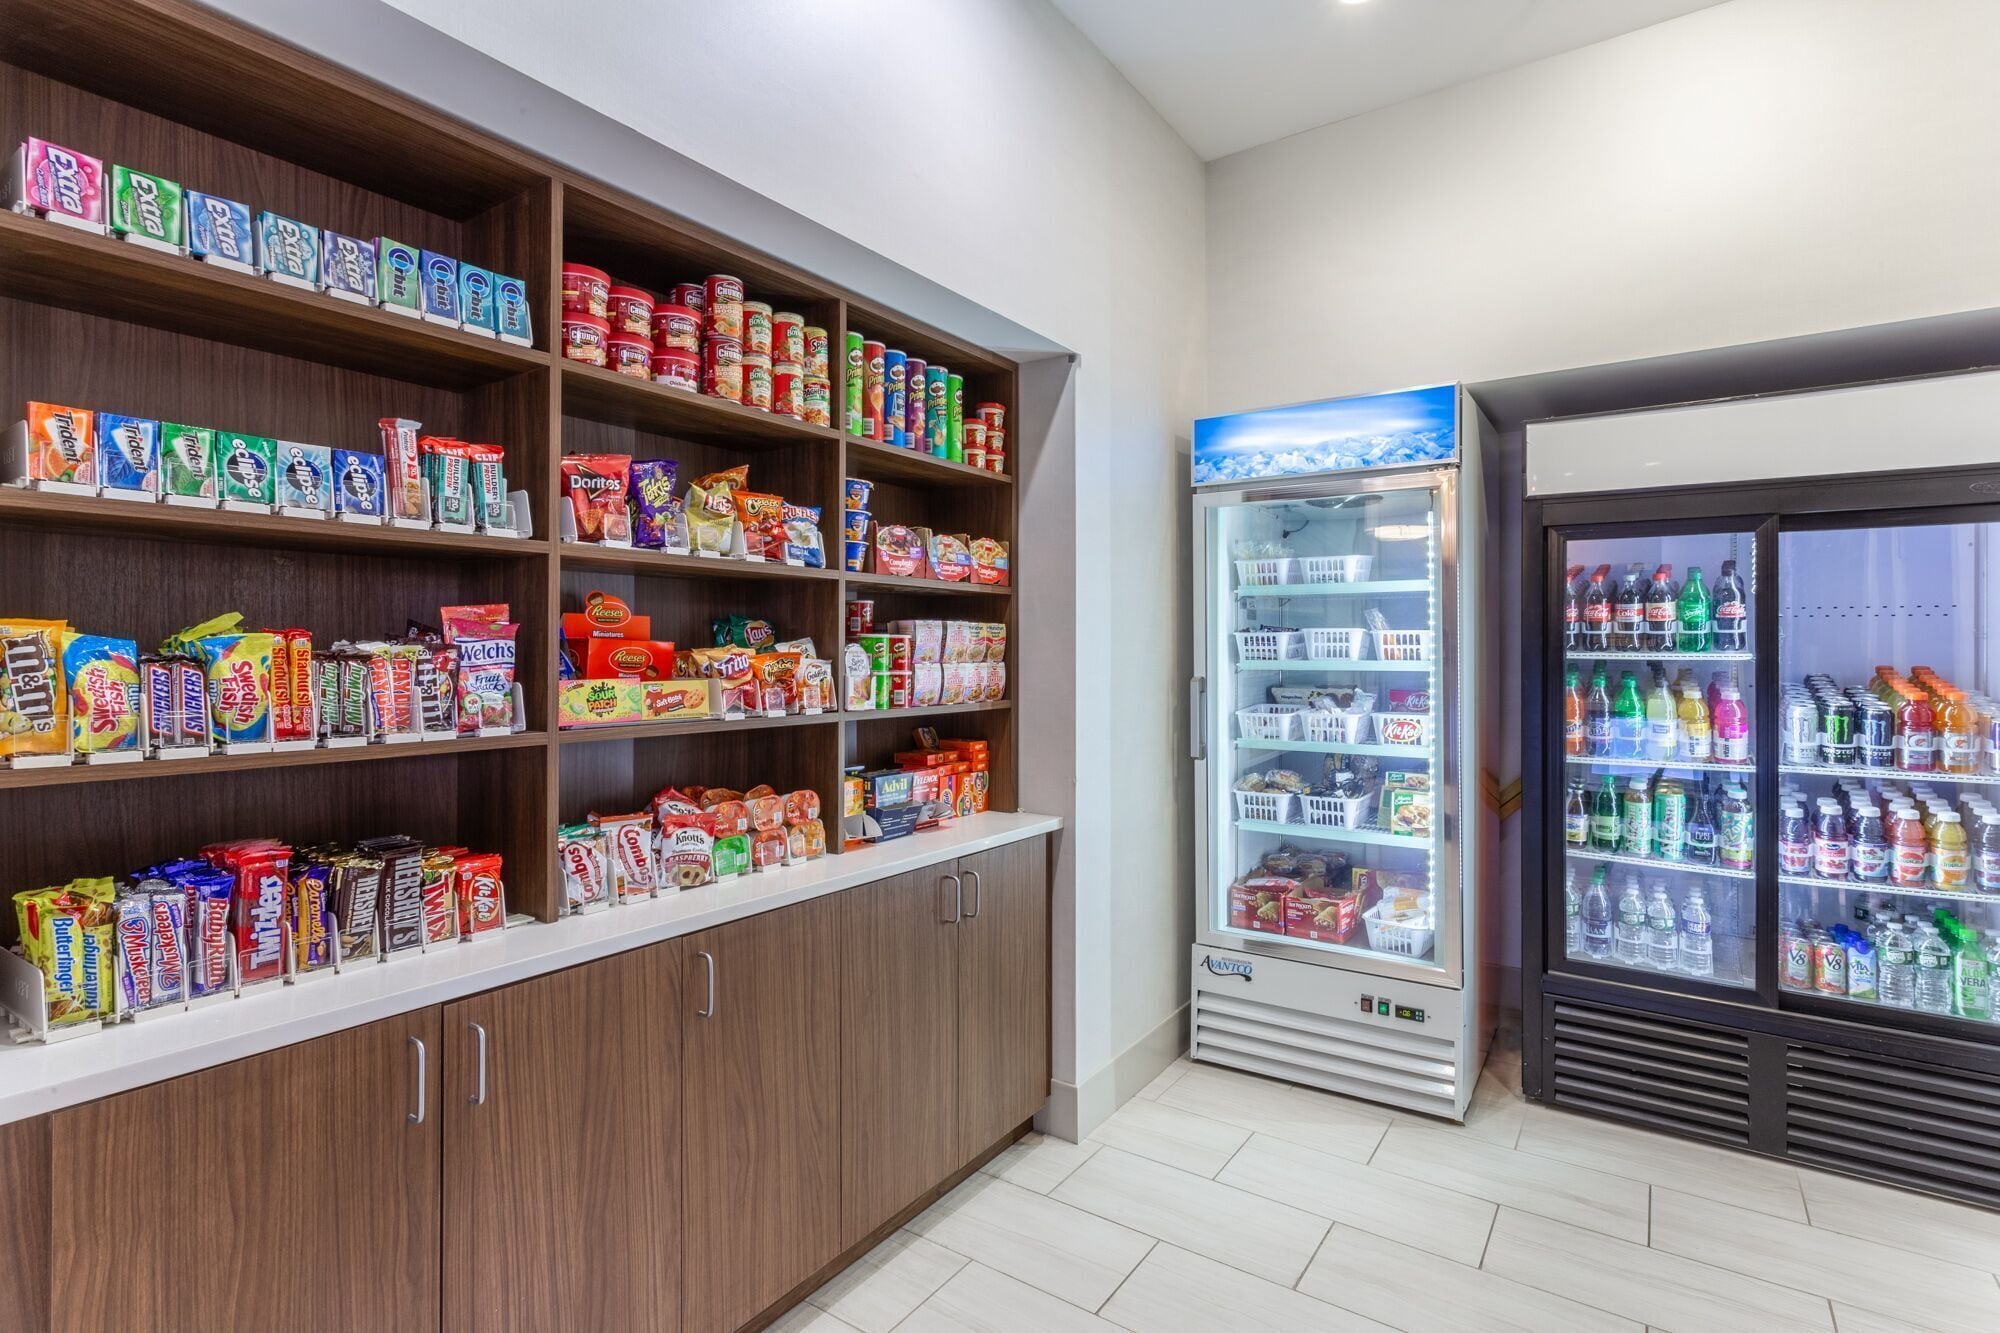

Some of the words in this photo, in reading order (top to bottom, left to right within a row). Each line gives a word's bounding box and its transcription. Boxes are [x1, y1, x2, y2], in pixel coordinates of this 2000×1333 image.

[47, 145, 83, 214] Extra
[129, 172, 165, 237] Extra
[205, 198, 240, 259] Extra
[277, 219, 304, 276] Extra
[337, 237, 364, 291] Extra
[388, 247, 415, 299] Orbit
[429, 258, 456, 310] Orbit
[465, 271, 491, 321] Orbit
[501, 282, 523, 330] Orbit
[54, 410, 81, 465] Trident
[122, 420, 148, 473] Trident
[181, 431, 206, 481] Trident
[232, 438, 261, 498] eclipse
[290, 447, 318, 505] eclipse
[347, 455, 373, 510] eclipse
[483, 465, 491, 494] PROTEIN
[571, 475, 621, 490] Doritos
[639, 477, 671, 506] Takis
[461, 643, 514, 661] Welch's
[593, 630, 624, 638] Miniatures
[86, 667, 118, 734] Swedish
[105, 681, 128, 719] Fish
[151, 668, 173, 734] SNICKERS
[183, 669, 204, 733] SNICKERS
[219, 676, 239, 712] Fish
[232, 660, 260, 724] Swedish
[371, 657, 397, 729] PAYDAY
[392, 658, 412, 728] PAYDAY
[470, 681, 506, 692] Snacks
[475, 673, 501, 684] Fruit
[588, 689, 616, 701] SOUR
[588, 700, 618, 711] PATCH
[882, 778, 908, 794] Advil
[624, 829, 651, 882] Combos
[675, 831, 705, 845] Knott's
[569, 847, 595, 900] Combos
[250, 874, 283, 970] Twizzlers
[351, 875, 379, 945] HERSHEY'S
[393, 859, 421, 945] HERSHEY'S
[422, 871, 450, 942] TWIX
[52, 917, 76, 994] Butterfinger
[154, 902, 181, 974] Musketeers
[1789, 950, 1806, 965] V8
[1825, 953, 1842, 970] V8
[1200, 954, 1252, 976] AVANTCO
[1960, 977, 1986, 988] VERA
